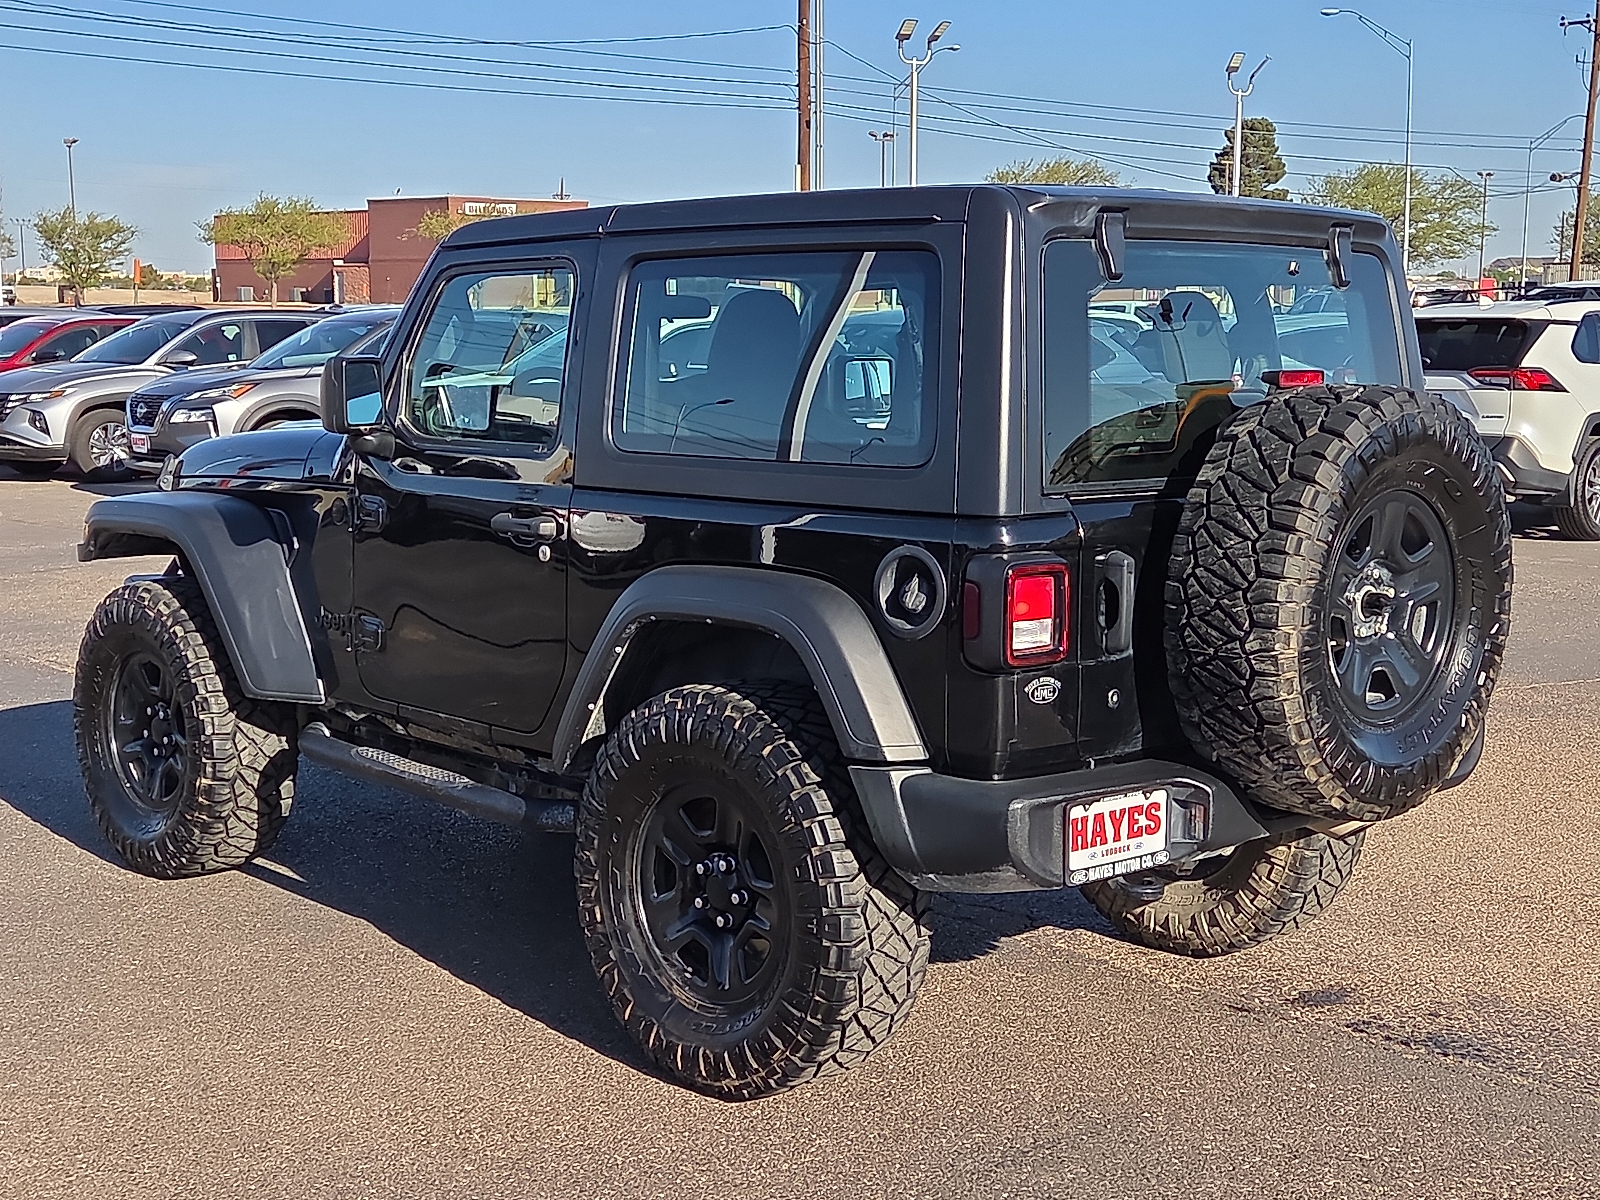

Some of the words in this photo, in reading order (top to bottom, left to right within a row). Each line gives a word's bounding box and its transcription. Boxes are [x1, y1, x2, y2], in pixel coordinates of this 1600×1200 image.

[1034, 686, 1053, 700] HMC
[1071, 802, 1162, 852] HAYES
[1088, 863, 1114, 881] HAYES
[1115, 857, 1141, 875] MOTOR
[1141, 854, 1154, 869] CO.
